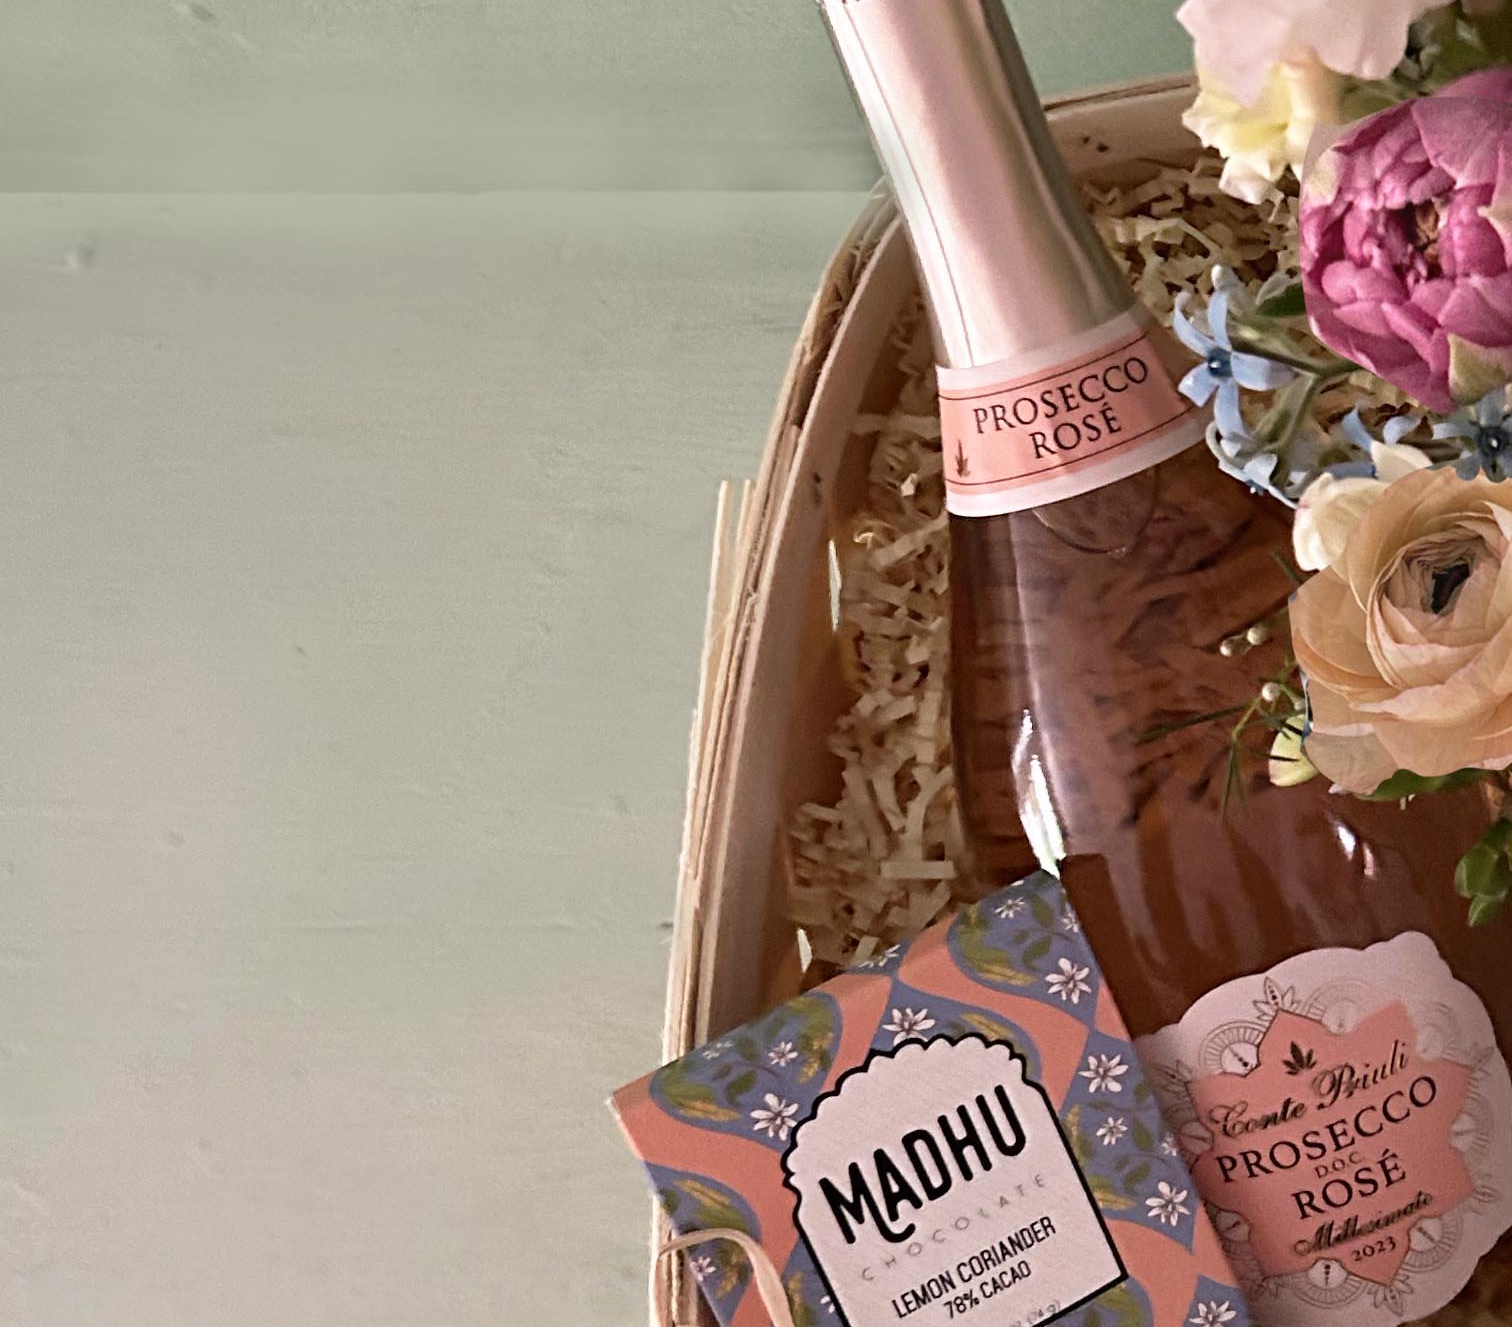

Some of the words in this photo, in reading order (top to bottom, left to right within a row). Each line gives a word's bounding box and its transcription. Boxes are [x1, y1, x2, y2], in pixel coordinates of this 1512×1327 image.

[973, 357, 1148, 434] PROSECCO
[1029, 401, 1121, 459] ROSÉ
[1209, 1097, 1307, 1138] Conte
[1216, 1076, 1437, 1183] PROSECCO
[818, 1084, 1027, 1245] MADHU
[1291, 1148, 1406, 1220] ROSÉ
[860, 1174, 1045, 1283] CHOCOLATE
[1352, 1236, 1397, 1262] 2023
[891, 1269, 956, 1319] LEMON
[956, 1216, 1057, 1283] CORIANDER
[943, 1289, 980, 1320] 78%
[979, 1260, 1032, 1299] CACAO
